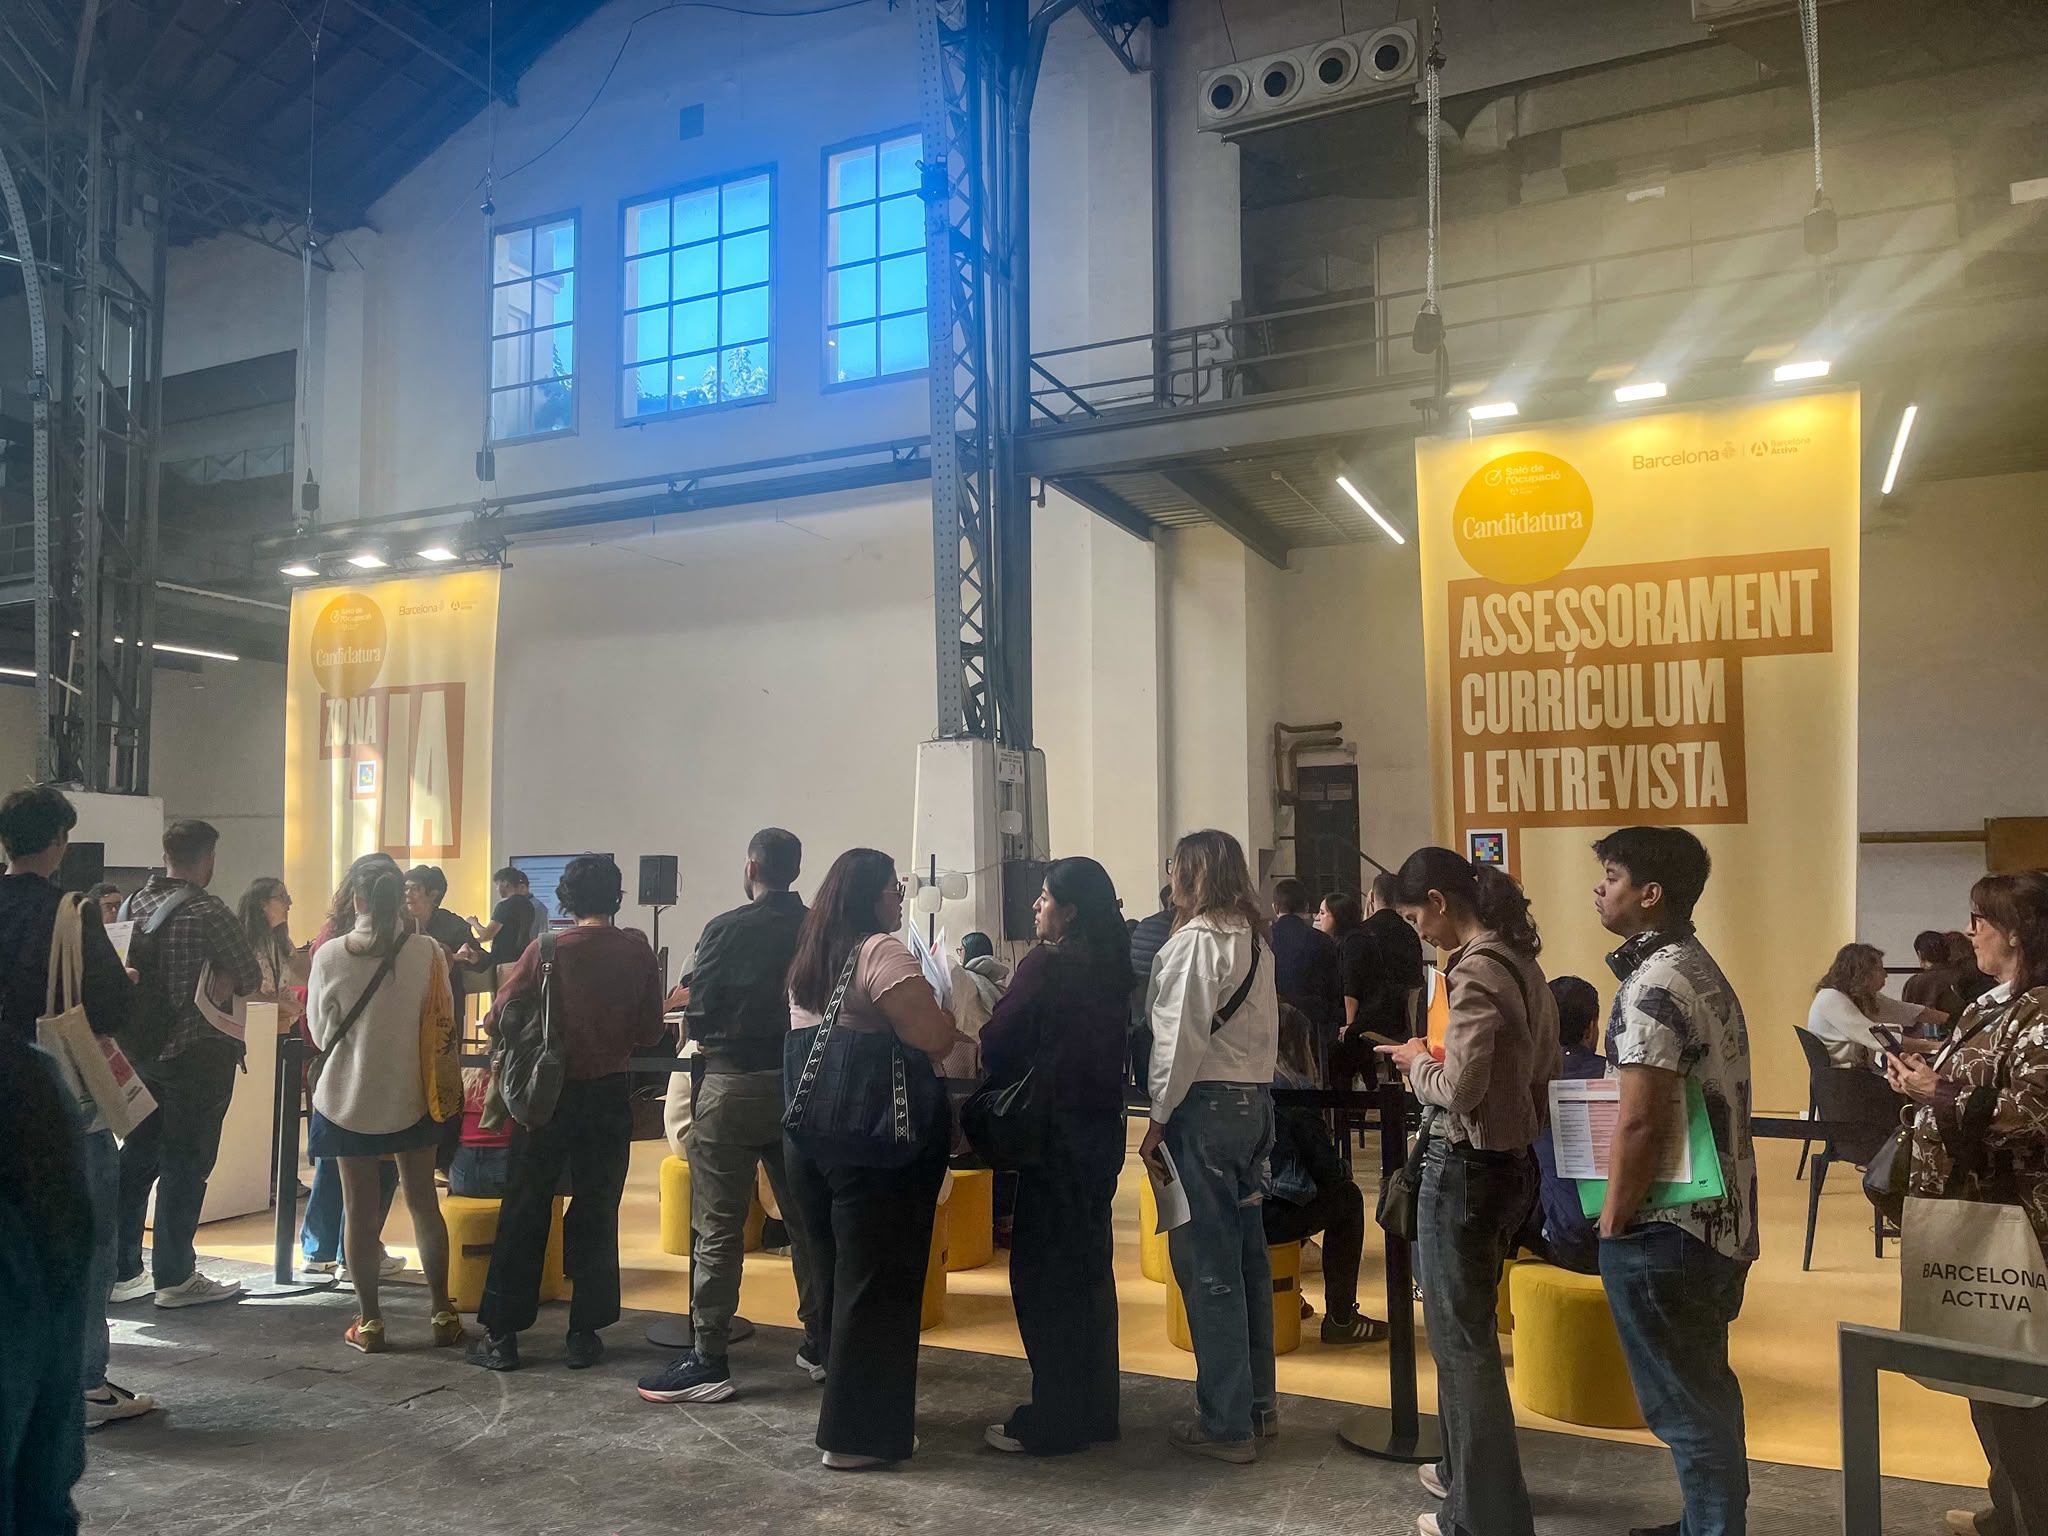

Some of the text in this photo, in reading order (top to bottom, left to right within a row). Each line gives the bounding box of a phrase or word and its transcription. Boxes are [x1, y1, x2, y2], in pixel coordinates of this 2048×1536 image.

[1632, 449, 1720, 470] Barcelona
[1771, 446, 1798, 455] Activa
[1530, 464, 1545, 473] de
[1462, 511, 1583, 540] Candidatura
[399, 604, 438, 616] Barcelona
[1459, 568, 1819, 658] ASSESSORAMENT
[316, 646, 381, 667] Candidatura
[1461, 651, 1726, 736] CURRÍCULUM
[324, 690, 454, 847] ZONA IA
[1463, 741, 1729, 814] I ENTREVISTA
[1922, 1262, 2048, 1291] BARCELONA
[1941, 1290, 2032, 1313] ACTIVA
